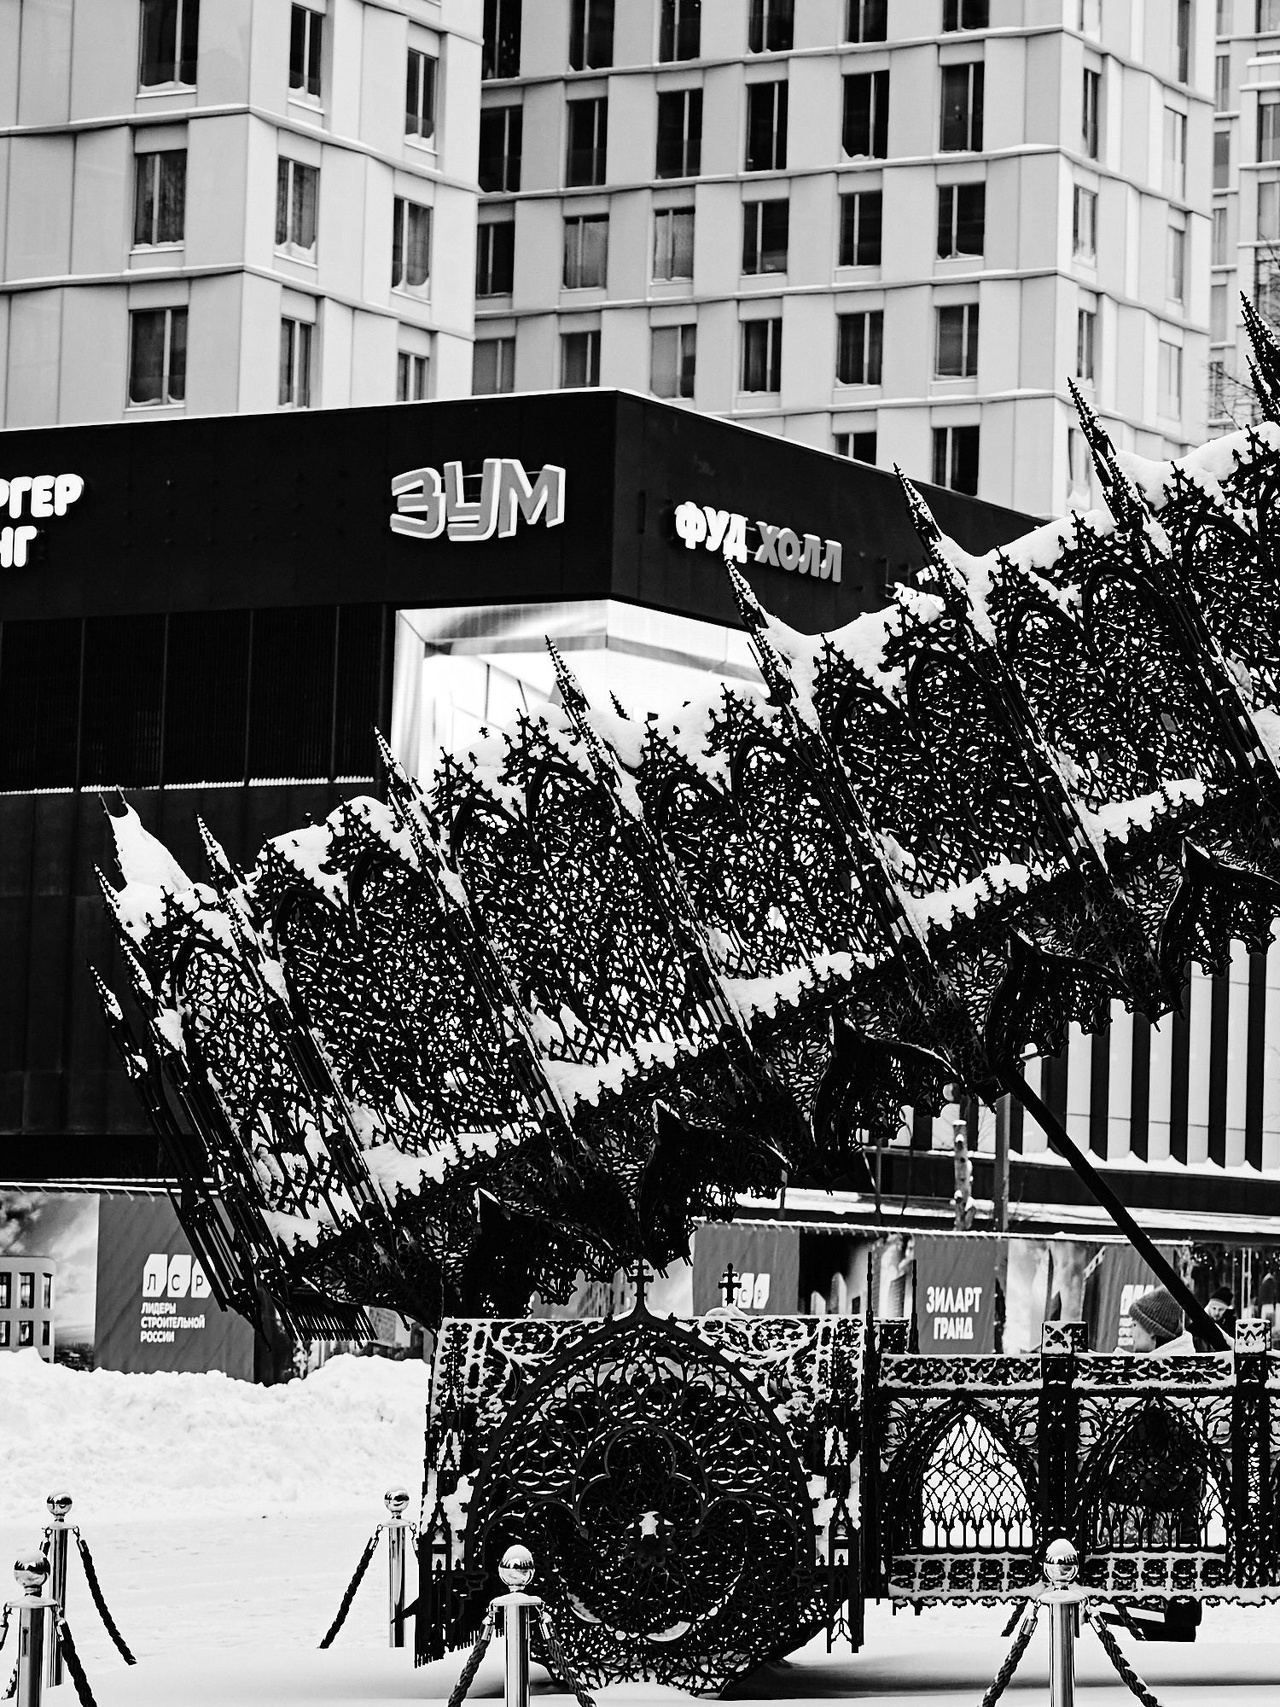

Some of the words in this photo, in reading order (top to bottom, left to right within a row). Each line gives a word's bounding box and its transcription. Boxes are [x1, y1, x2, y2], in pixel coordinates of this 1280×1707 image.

[390, 458, 566, 541] ЗУМ
[674, 501, 748, 564] ФУД
[754, 521, 842, 583] ХОЛЛ
[141, 1302, 177, 1316] ЛИДЕРЫ
[926, 1286, 982, 1313] ЗИЛАРТ
[141, 1314, 206, 1329] СТРОИТЕЛЬНОЙ
[933, 1316, 974, 1340] ГРАНД
[140, 1330, 175, 1343] РОССИИ
